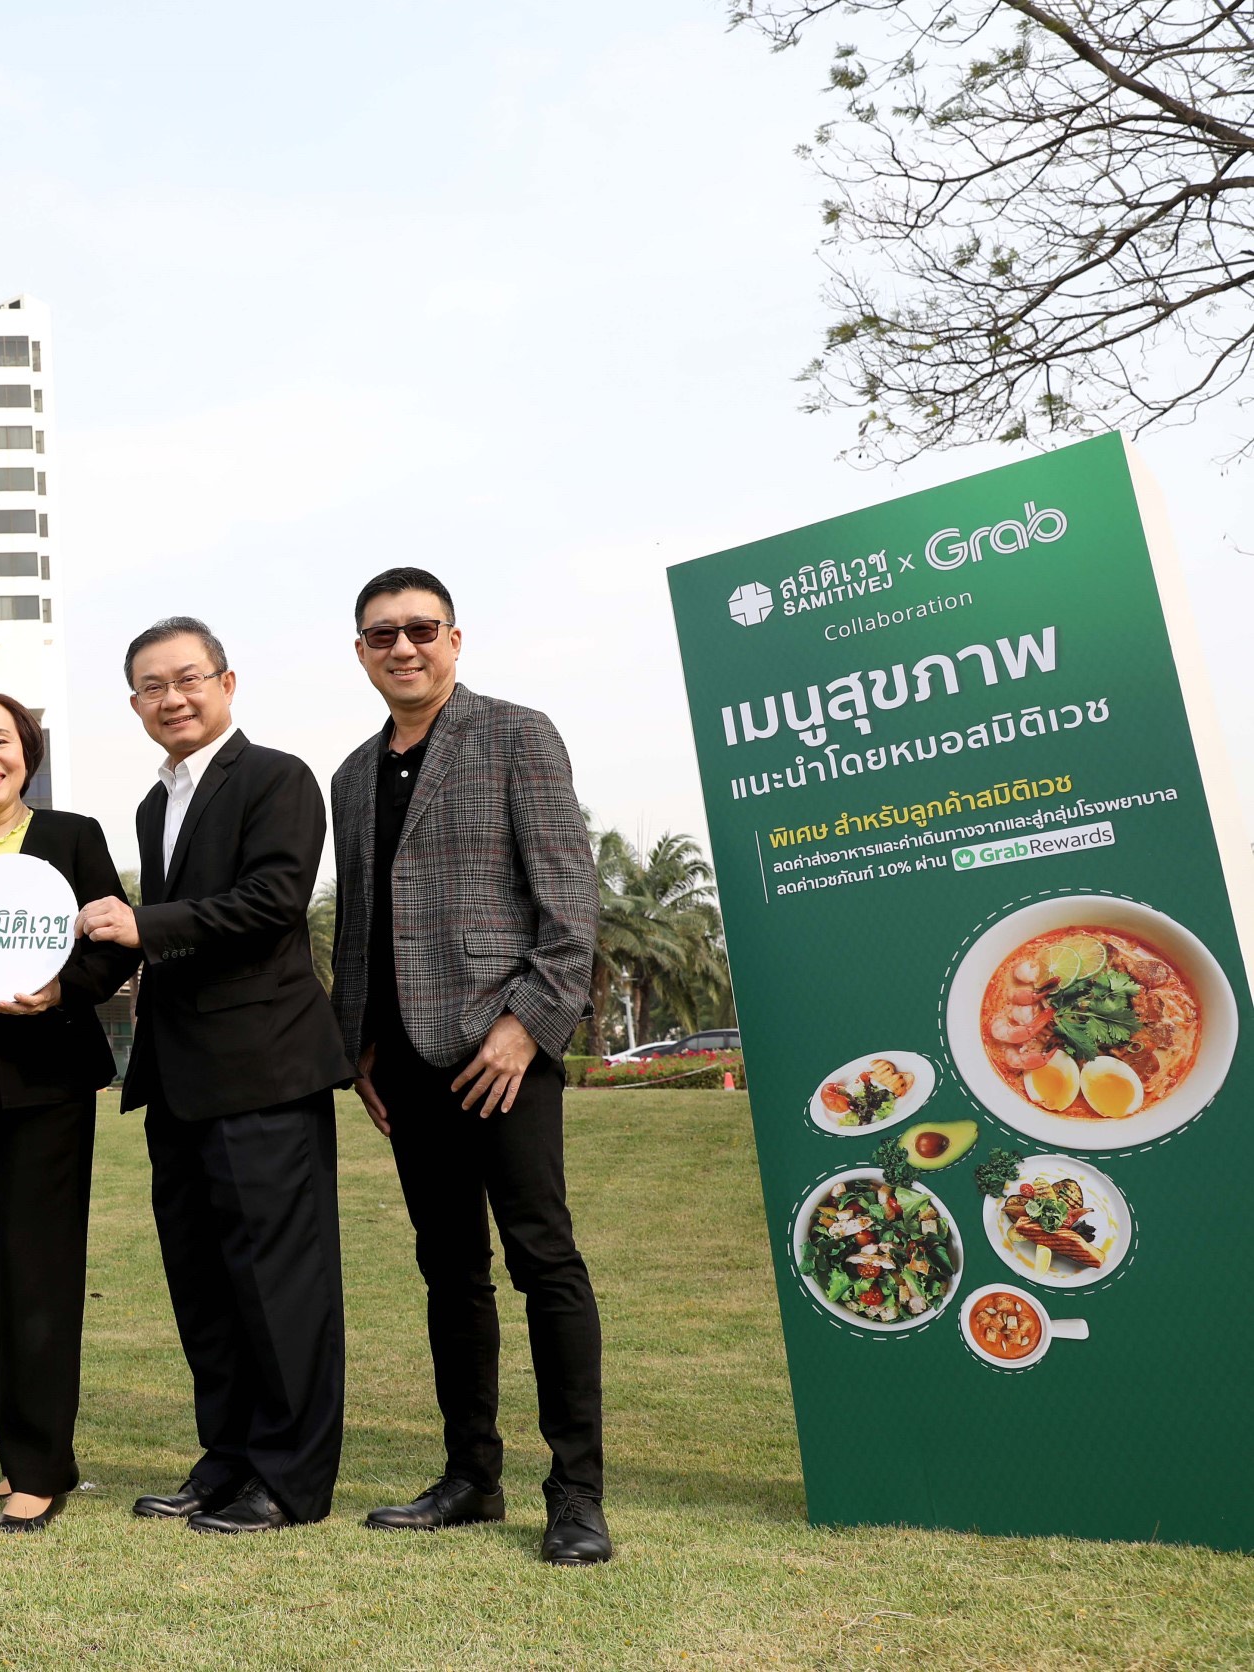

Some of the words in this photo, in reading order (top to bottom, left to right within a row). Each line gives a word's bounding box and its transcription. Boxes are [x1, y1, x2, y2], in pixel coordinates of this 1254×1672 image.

[779, 549, 888, 600] สมิติเวช
[924, 500, 1068, 571] Grab
[783, 573, 894, 617] SAMITIVEJ
[824, 590, 973, 642] Collaboration
[721, 625, 1056, 748] เมนูสุขภาพ
[731, 697, 1110, 800] แนะนำโดยหมอสมิติเวช
[769, 823, 829, 849] พิเศษ
[834, 774, 1072, 837] สำหรับลูกค้าสมิติเวช
[776, 865, 874, 895] ลดค่าเวชภัณฑ์
[878, 860, 912, 878] 10%
[915, 854, 947, 872] ผ่าน
